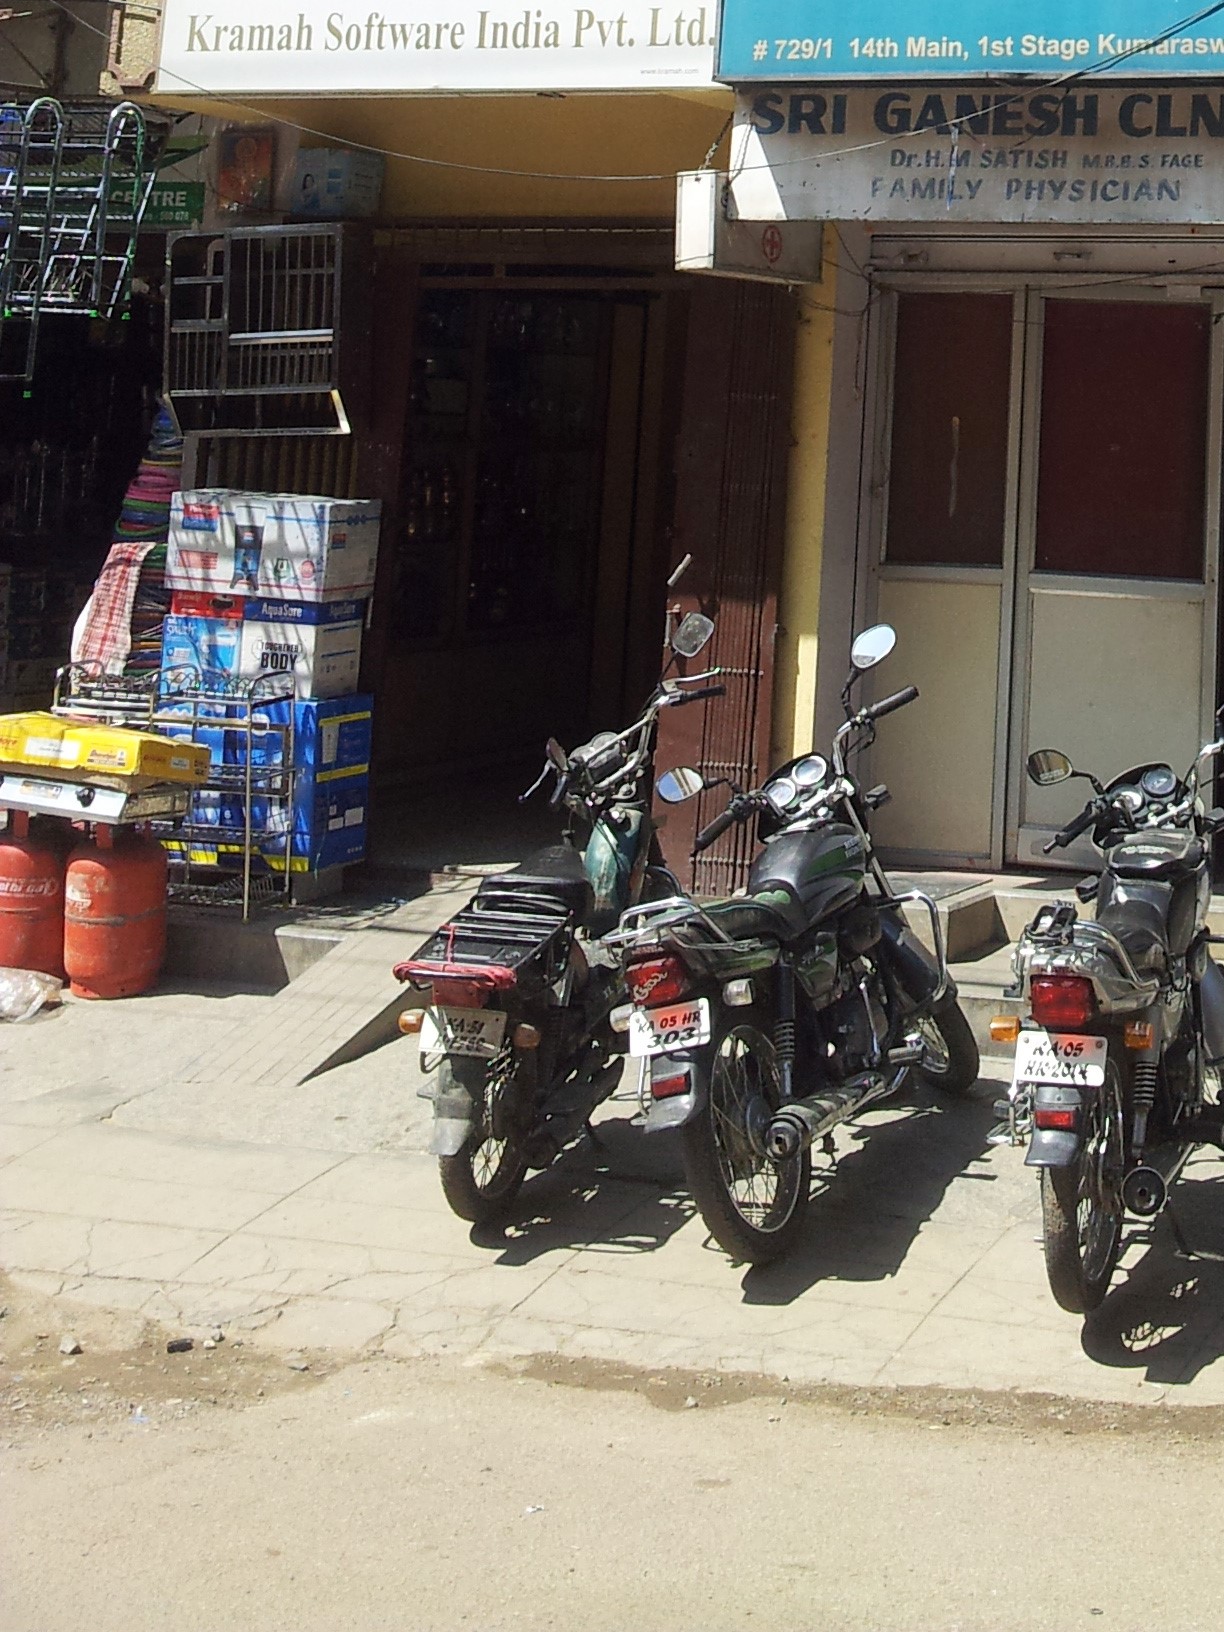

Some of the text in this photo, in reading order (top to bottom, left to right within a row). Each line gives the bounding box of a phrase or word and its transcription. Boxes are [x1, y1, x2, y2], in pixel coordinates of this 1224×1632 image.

[185, 7, 715, 52] Kramah Software India Pvt. Ltd.
[774, 40, 833, 60] 729/1
[849, 38, 898, 58] 14th
[907, 37, 969, 61] Main,
[977, 36, 1014, 57] 1st
[1021, 35, 1090, 60] Stage
[751, 94, 848, 135] SRI
[873, 92, 1098, 137] GANESH
[980, 149, 1067, 169] SATISH
[1161, 153, 1204, 169] FAGE
[871, 176, 1181, 203] FAMILY PHYSICIAN
[261, 652, 298, 670] BODY
[660, 1016, 677, 1029] 05
